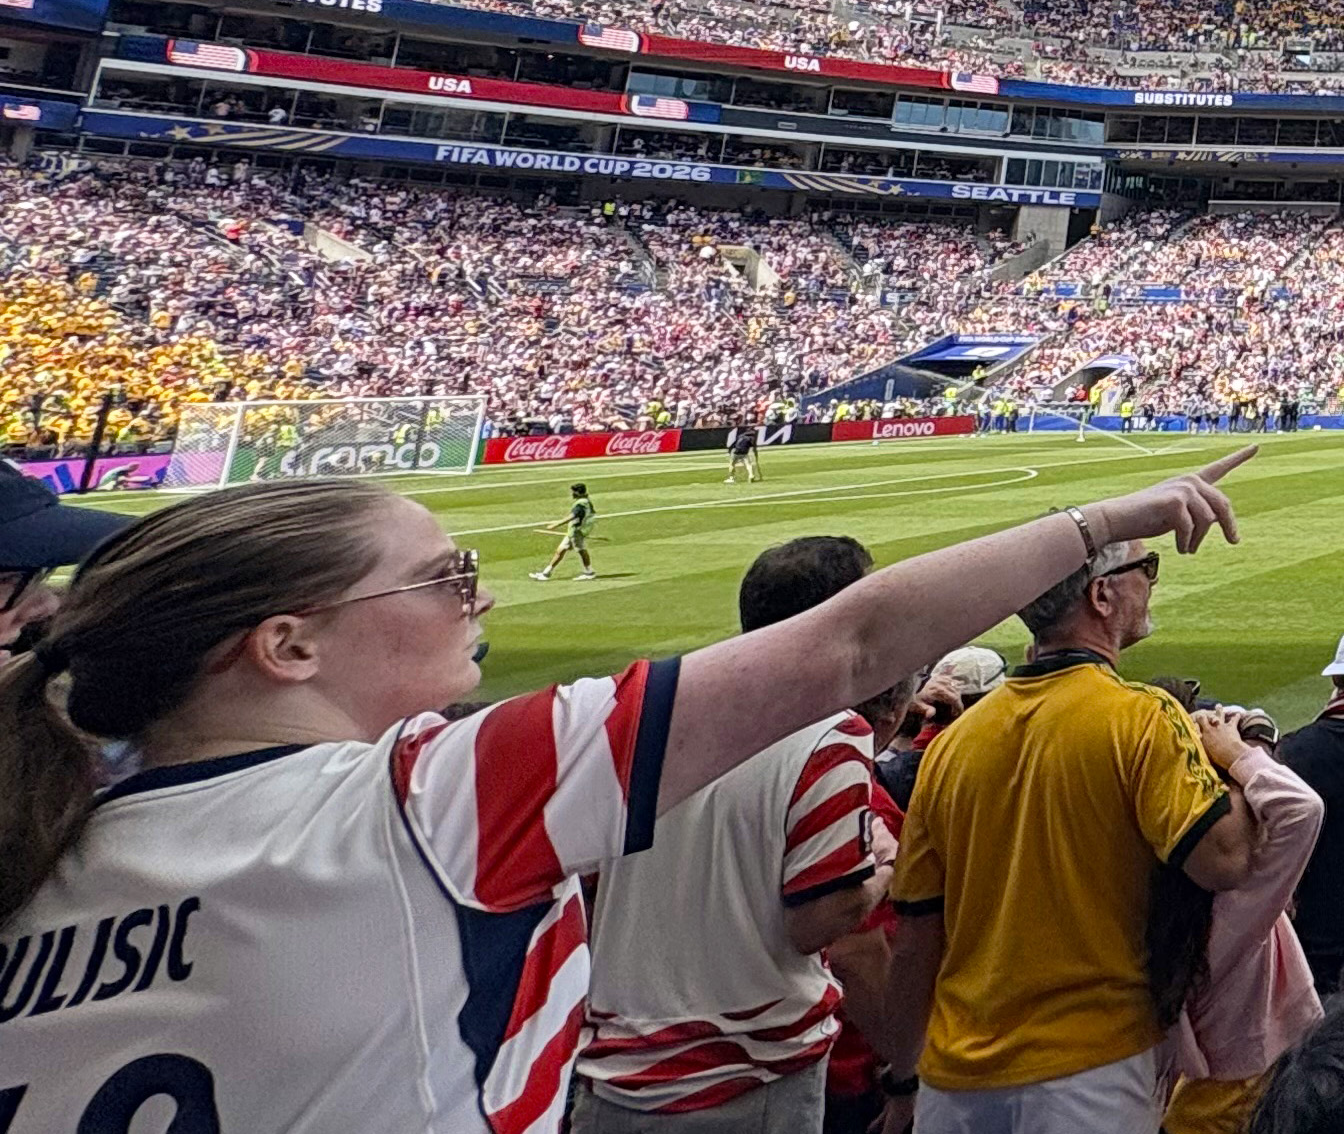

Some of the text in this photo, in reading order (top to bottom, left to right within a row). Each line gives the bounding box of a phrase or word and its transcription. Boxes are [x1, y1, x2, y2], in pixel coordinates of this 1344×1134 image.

[785, 56, 820, 72] USA
[428, 76, 472, 94] USA
[1134, 91, 1233, 107] SUBSTITUTES
[435, 145, 711, 181] FIFA WORLD CUP 2026
[951, 185, 1076, 206] SEATTLE
[873, 420, 935, 438] Lenovo
[0, 897, 201, 1024] ULISIC
